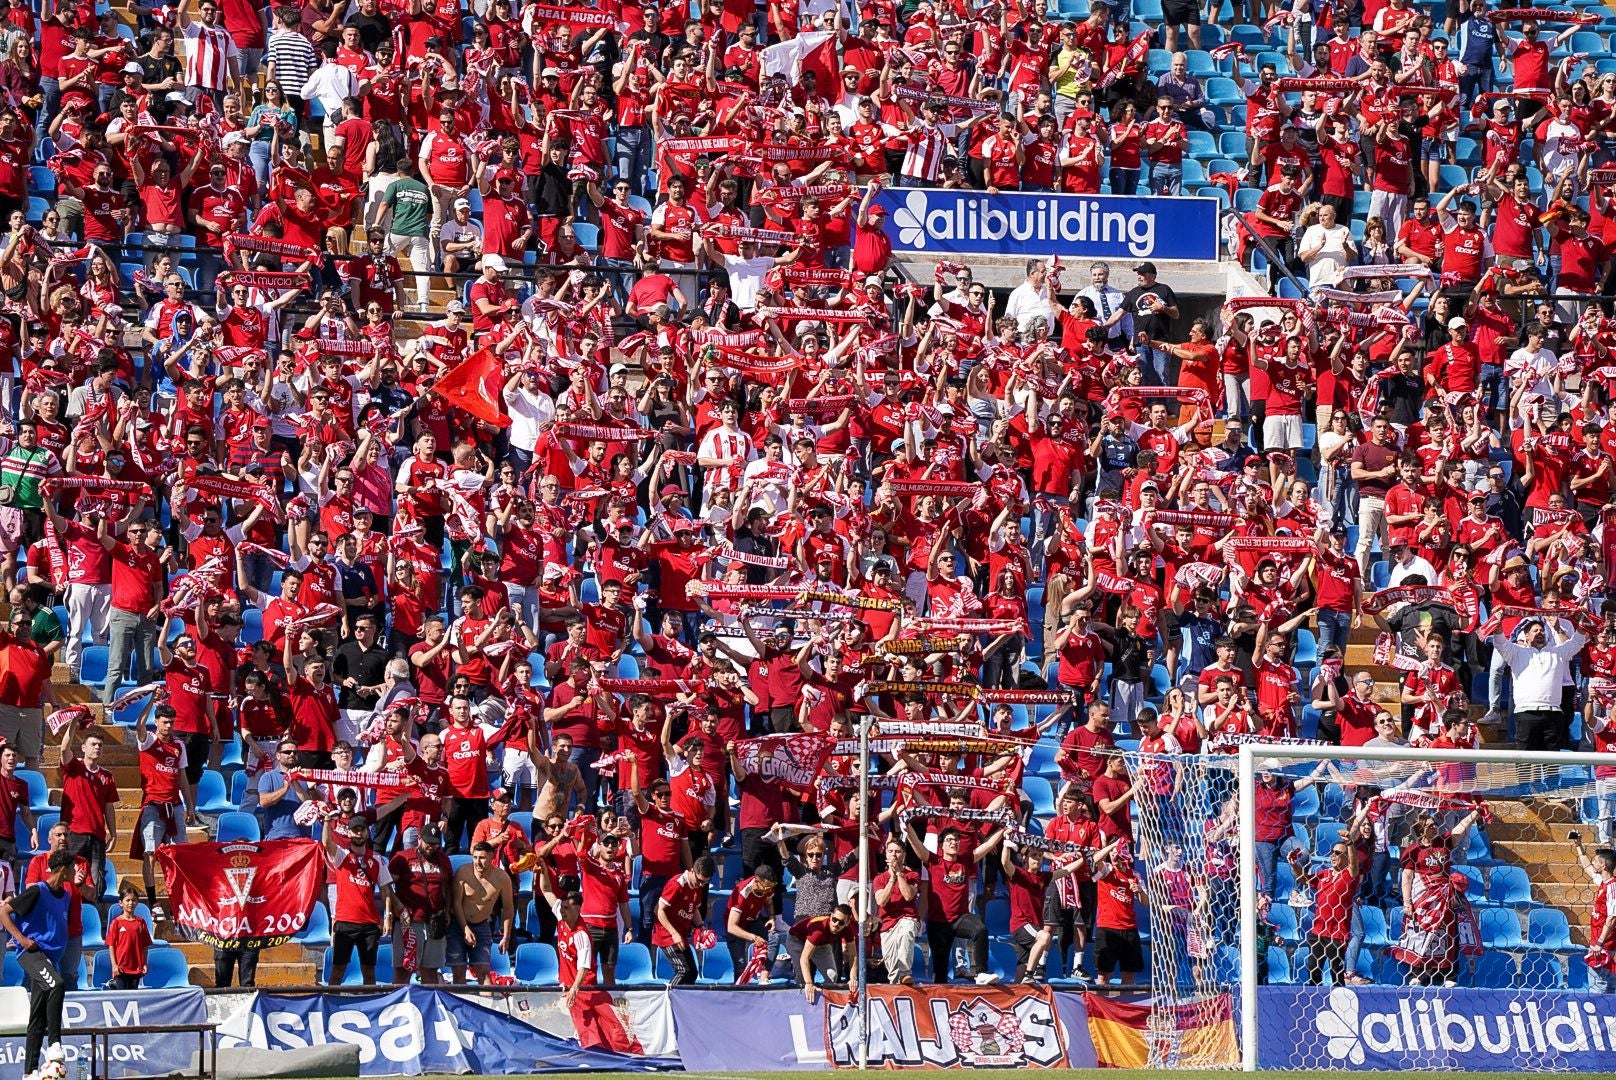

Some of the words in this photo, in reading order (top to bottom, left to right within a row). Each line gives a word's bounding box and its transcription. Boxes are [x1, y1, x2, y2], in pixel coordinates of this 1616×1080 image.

[538, 8, 567, 21] REAL
[570, 11, 614, 25] MURCIA
[1283, 80, 1302, 88] REAL
[1315, 80, 1349, 89] MURCIA
[779, 187, 804, 198] REAL
[806, 185, 843, 197] MURCIA
[926, 199, 1156, 258] alibuilding
[235, 272, 256, 286] real
[257, 274, 292, 286] murcia
[785, 268, 809, 278] Real
[812, 270, 850, 281] Murcia
[727, 353, 752, 365] REAL
[754, 356, 794, 368] MURCIA
[196, 478, 222, 489] MURCIA
[222, 482, 241, 493] CLUB
[242, 485, 250, 495] DE
[893, 483, 907, 491] REAL
[909, 483, 933, 492] MURCIA
[933, 484, 949, 492] CLUB
[1193, 513, 1211, 526] SOLA
[1212, 514, 1232, 527] ALMA
[724, 550, 743, 561] REAL
[744, 553, 774, 566] MURCIA
[1097, 573, 1113, 588] SOLA
[703, 584, 721, 593] REAL
[722, 583, 749, 593] MURCIA
[750, 584, 768, 593] CLUB
[770, 584, 778, 593] DE
[926, 683, 974, 697] NMOR
[879, 722, 913, 734] REAL
[919, 722, 980, 737] MURCIA
[834, 740, 861, 754] EAL
[452, 750, 480, 760] fibranet
[348, 770, 357, 783] ES
[357, 771, 366, 783] LA
[366, 772, 379, 785] QUE
[379, 772, 400, 786] CANTA
[903, 772, 929, 786] REAL
[930, 774, 976, 785] MURCIA
[980, 777, 998, 789] C.F.
[247, 939, 261, 949] en
